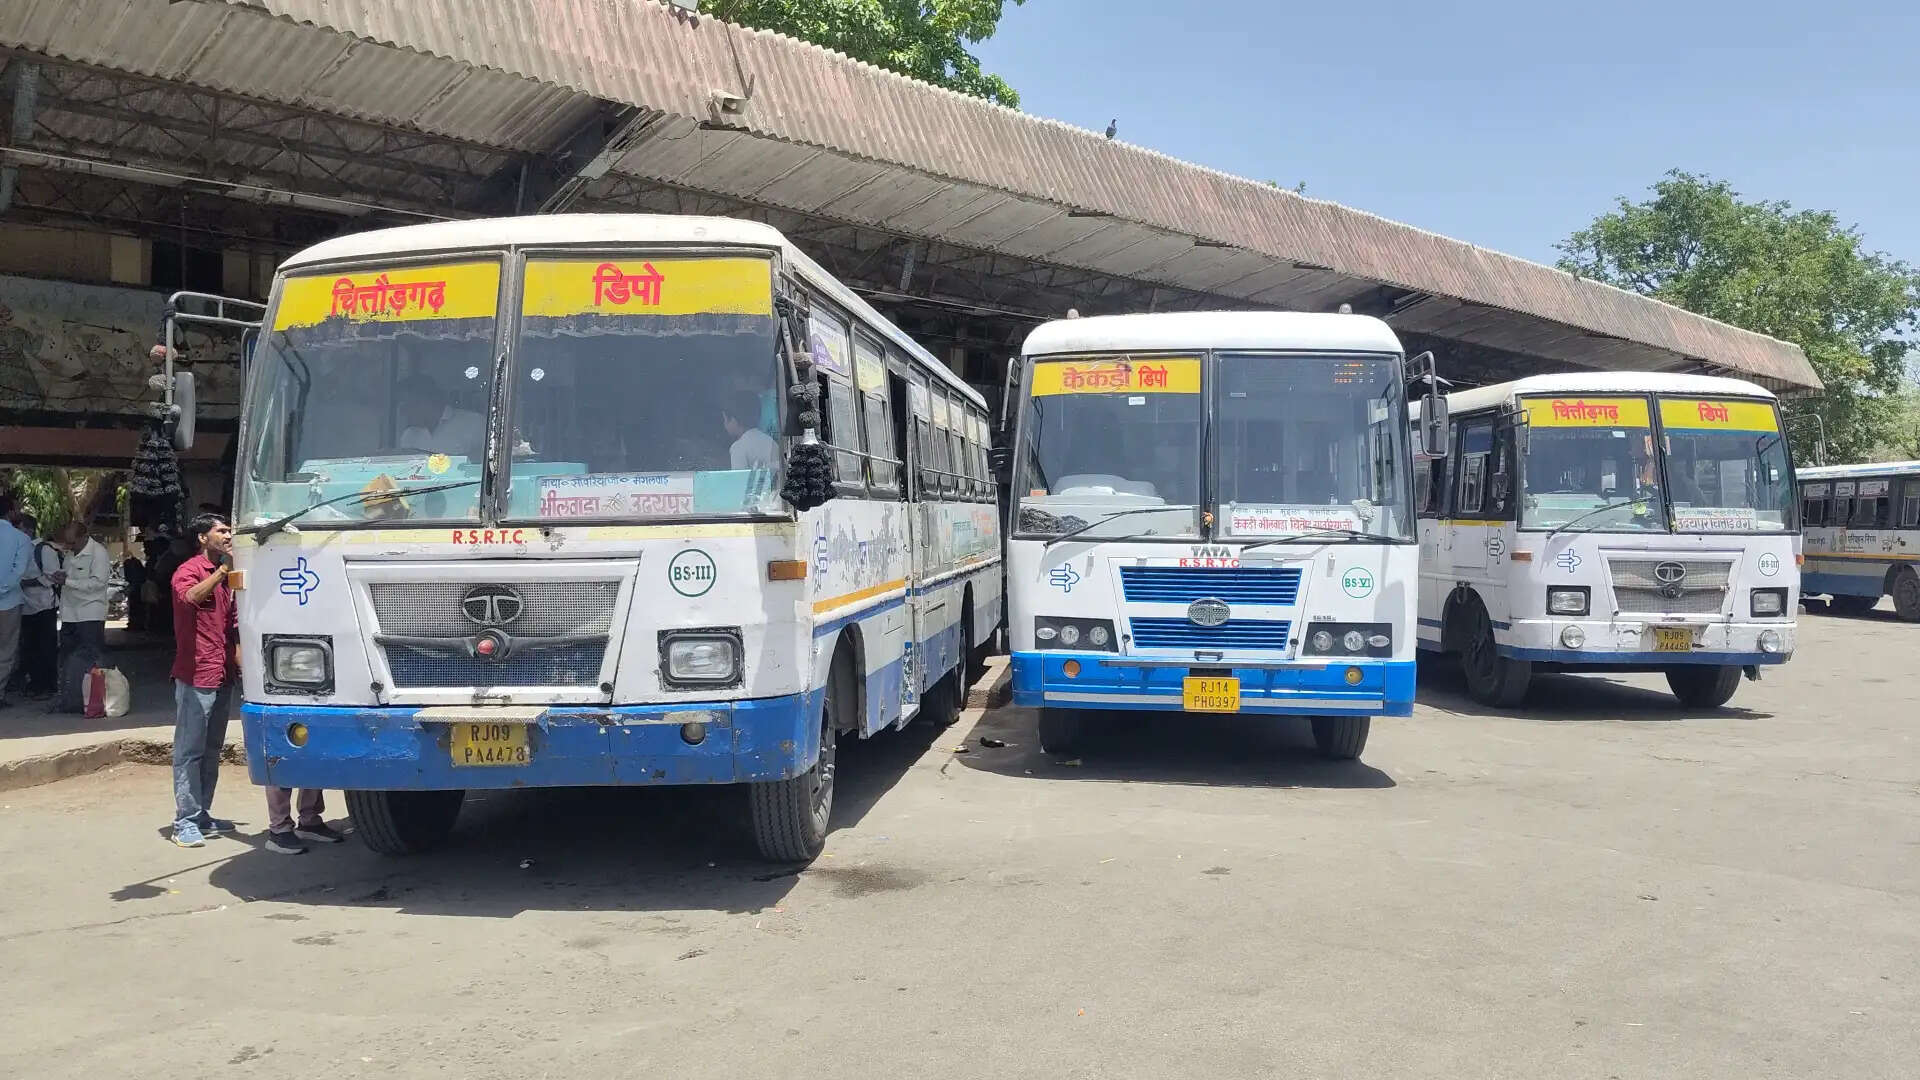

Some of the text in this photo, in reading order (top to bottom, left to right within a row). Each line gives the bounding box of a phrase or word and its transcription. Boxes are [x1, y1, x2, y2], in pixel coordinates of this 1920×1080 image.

[591, 261, 665, 306] डिपो
[1138, 364, 1168, 388] डिपो
[1697, 401, 1729, 422] डिपो
[453, 529, 528, 544] R.S.R.T.C.
[1191, 546, 1231, 558] TATA
[674, 565, 711, 581] BS-III
[1201, 681, 1229, 693] RJ14
[1194, 696, 1236, 708] PH0397
[471, 724, 510, 742] RJ09
